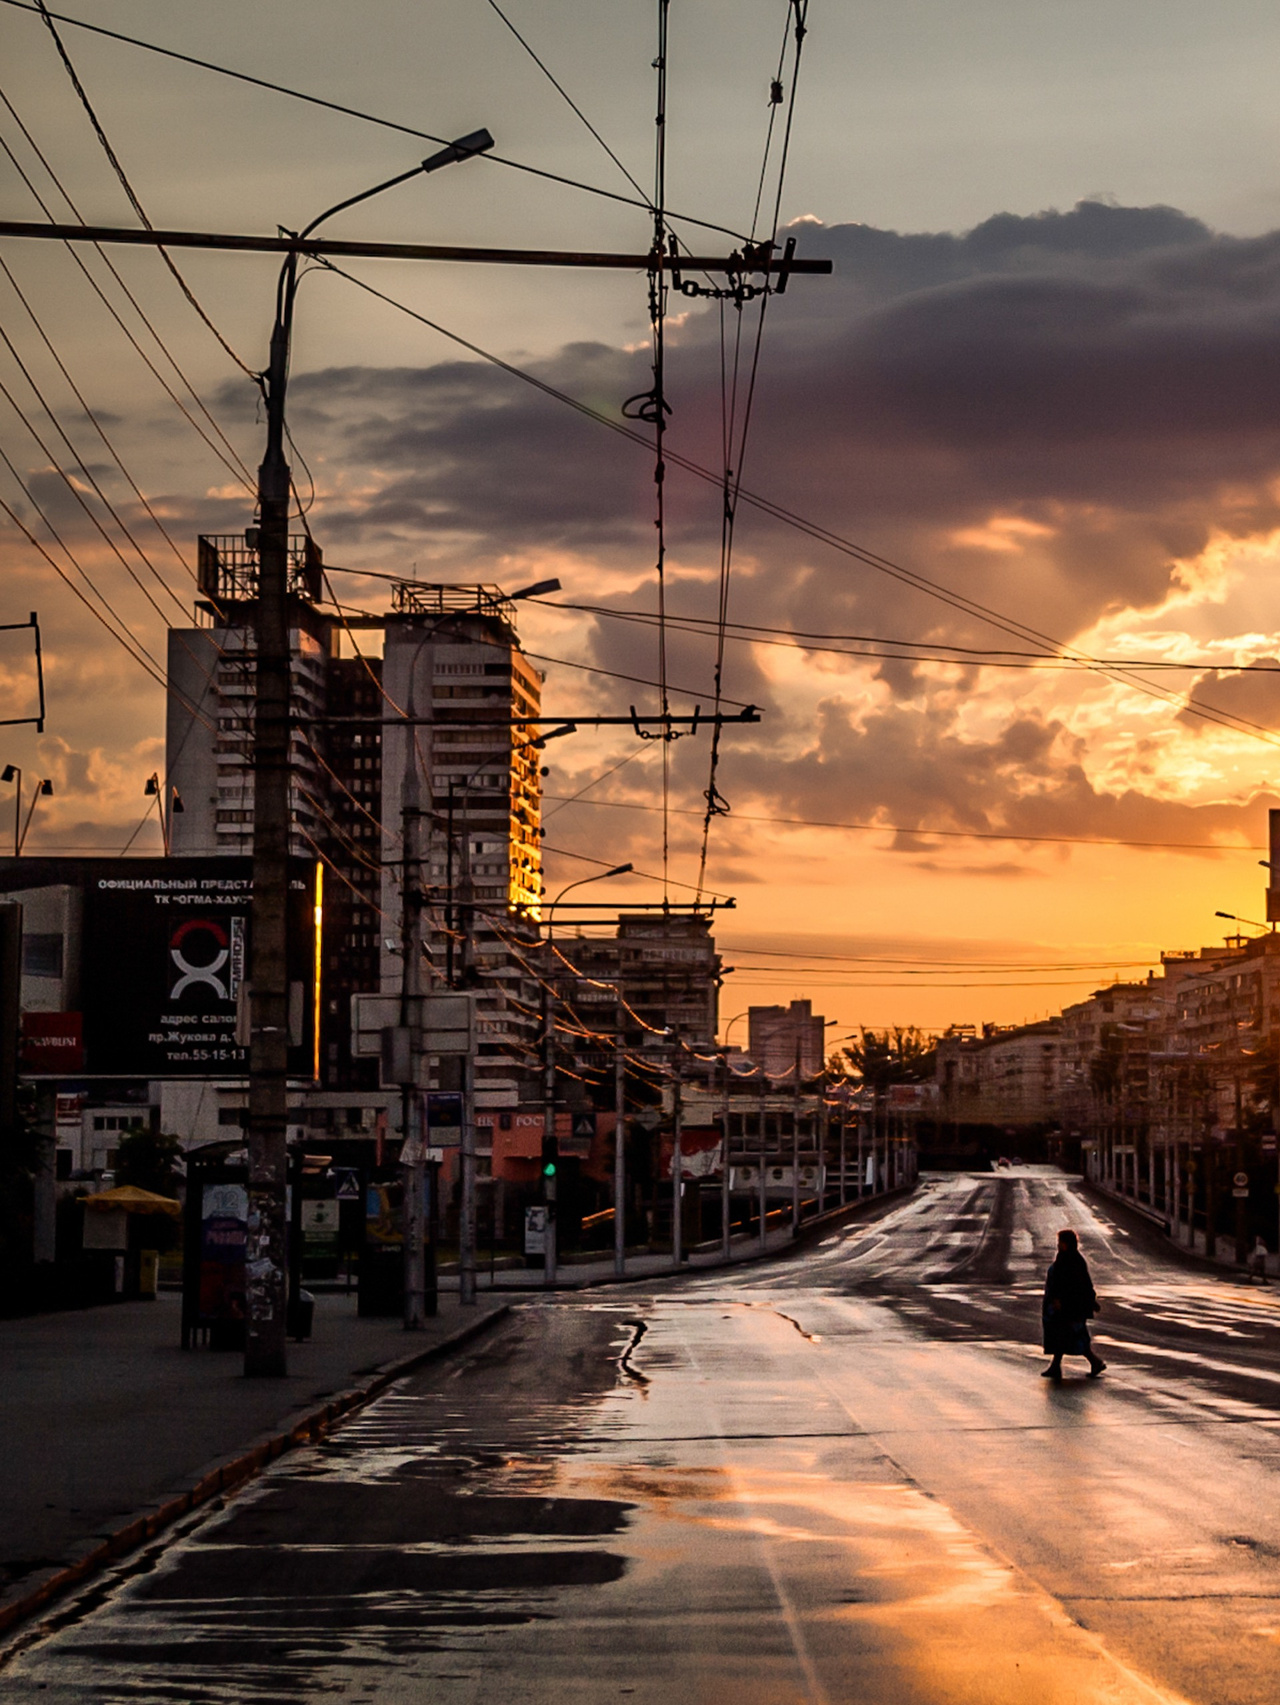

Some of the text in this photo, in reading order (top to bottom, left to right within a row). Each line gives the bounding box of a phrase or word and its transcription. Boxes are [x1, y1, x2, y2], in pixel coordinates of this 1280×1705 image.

[98, 879, 198, 890] ОФИЦИАЛЬНЫЙ
[154, 894, 170, 904] ТК
[160, 1014, 238, 1026] адрес сало
[148, 1031, 216, 1045] пр.Жукова
[166, 1049, 245, 1061] тел.55-15-13
